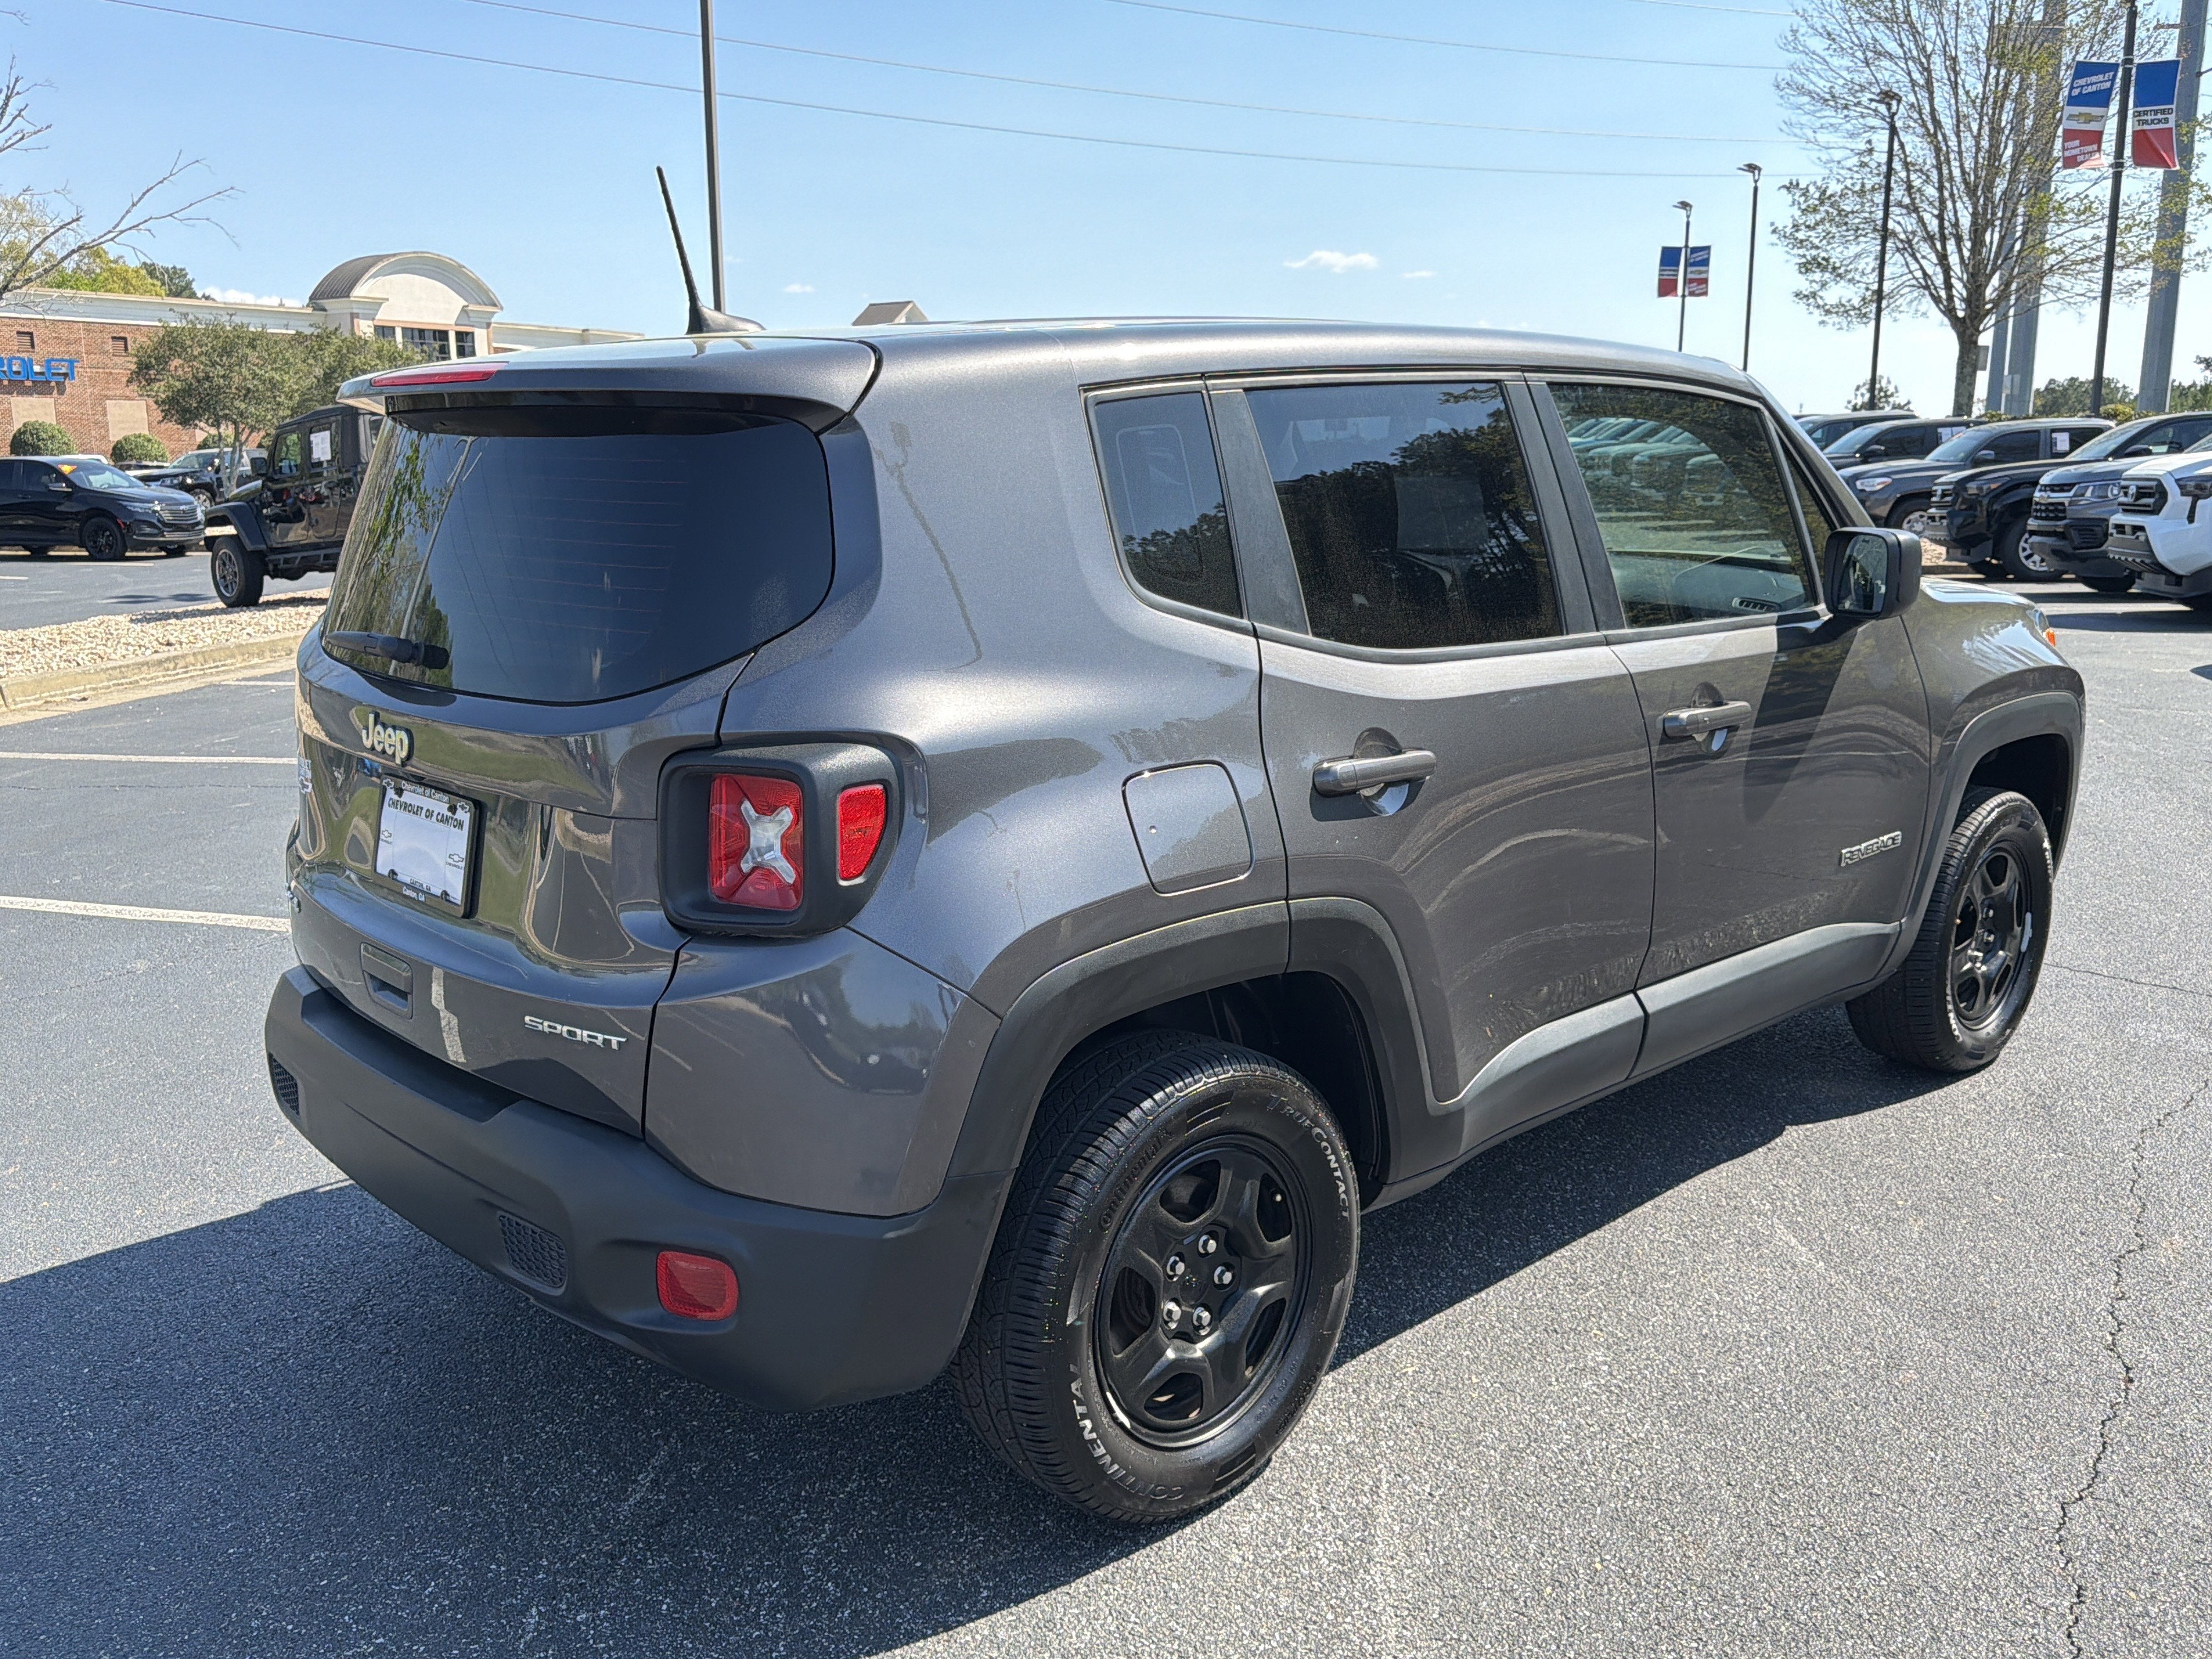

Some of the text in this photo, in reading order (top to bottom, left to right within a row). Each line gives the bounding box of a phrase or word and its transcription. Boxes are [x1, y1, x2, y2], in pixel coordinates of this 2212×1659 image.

[2071, 81, 2111, 97] OF CANTON
[2073, 71, 2114, 87] CHEVROLET
[2133, 108, 2173, 117] CERTIFIED
[2136, 117, 2169, 126] TRUCKS
[362, 712, 410, 765] Jeep
[402, 780, 424, 794] Chevrolet
[431, 789, 450, 804] Canton
[388, 797, 465, 831] CHEVROLET OF CANTON
[1841, 831, 1902, 867] RENEGADE
[524, 1015, 629, 1051] SPORT
